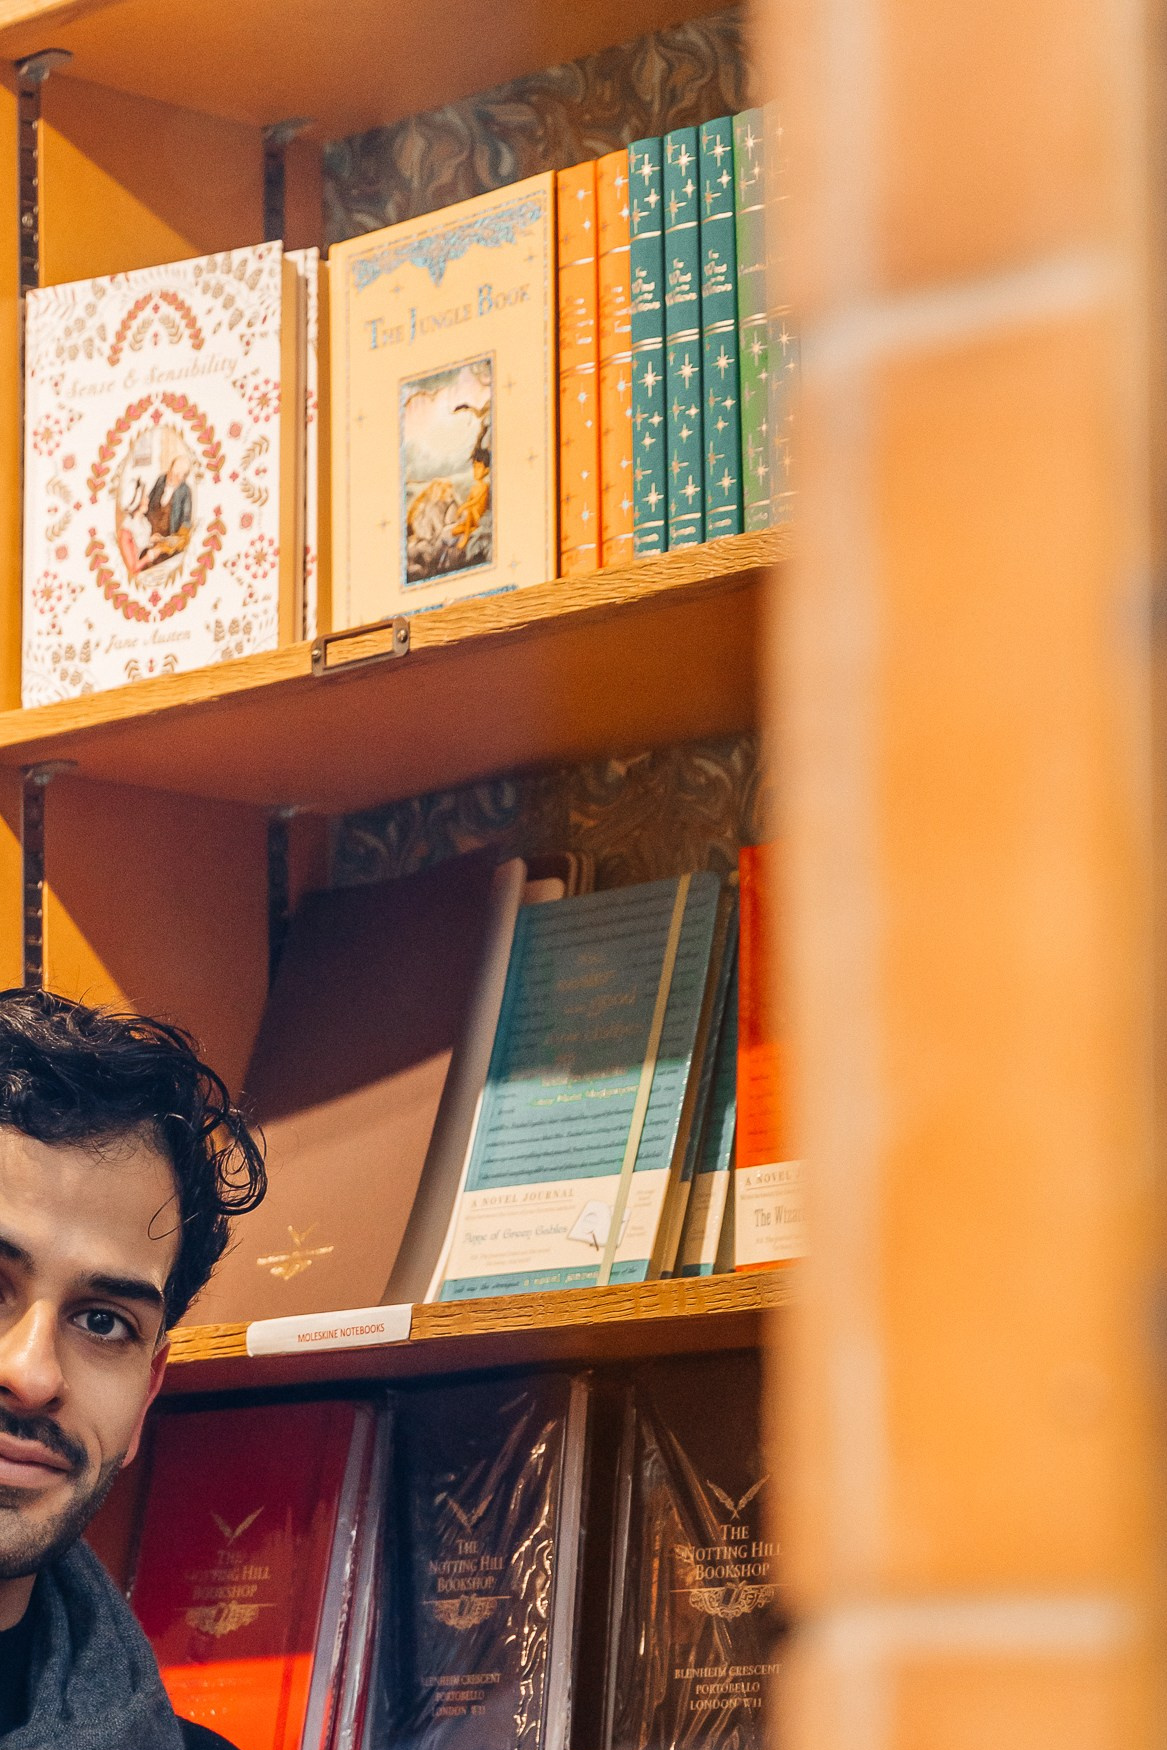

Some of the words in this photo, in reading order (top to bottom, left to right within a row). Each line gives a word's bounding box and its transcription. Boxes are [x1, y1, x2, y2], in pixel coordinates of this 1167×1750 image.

[298, 1329, 338, 1342] MOLESKINE
[340, 1323, 385, 1337] NOTEBOOKS
[720, 1524, 750, 1541] THE
[456, 1539, 478, 1555] THE
[685, 1546, 748, 1563] NOTTING
[752, 1541, 782, 1558] HILL
[480, 1555, 504, 1571] HILL
[695, 1563, 770, 1581] BOOKSHOP
[437, 1576, 495, 1593] BOOKSHOP
[674, 1667, 727, 1679] BLENHEIM
[728, 1664, 782, 1676] CRESCENT
[695, 1682, 760, 1694] PORTOBELLO
[690, 1698, 737, 1711] LONDON
